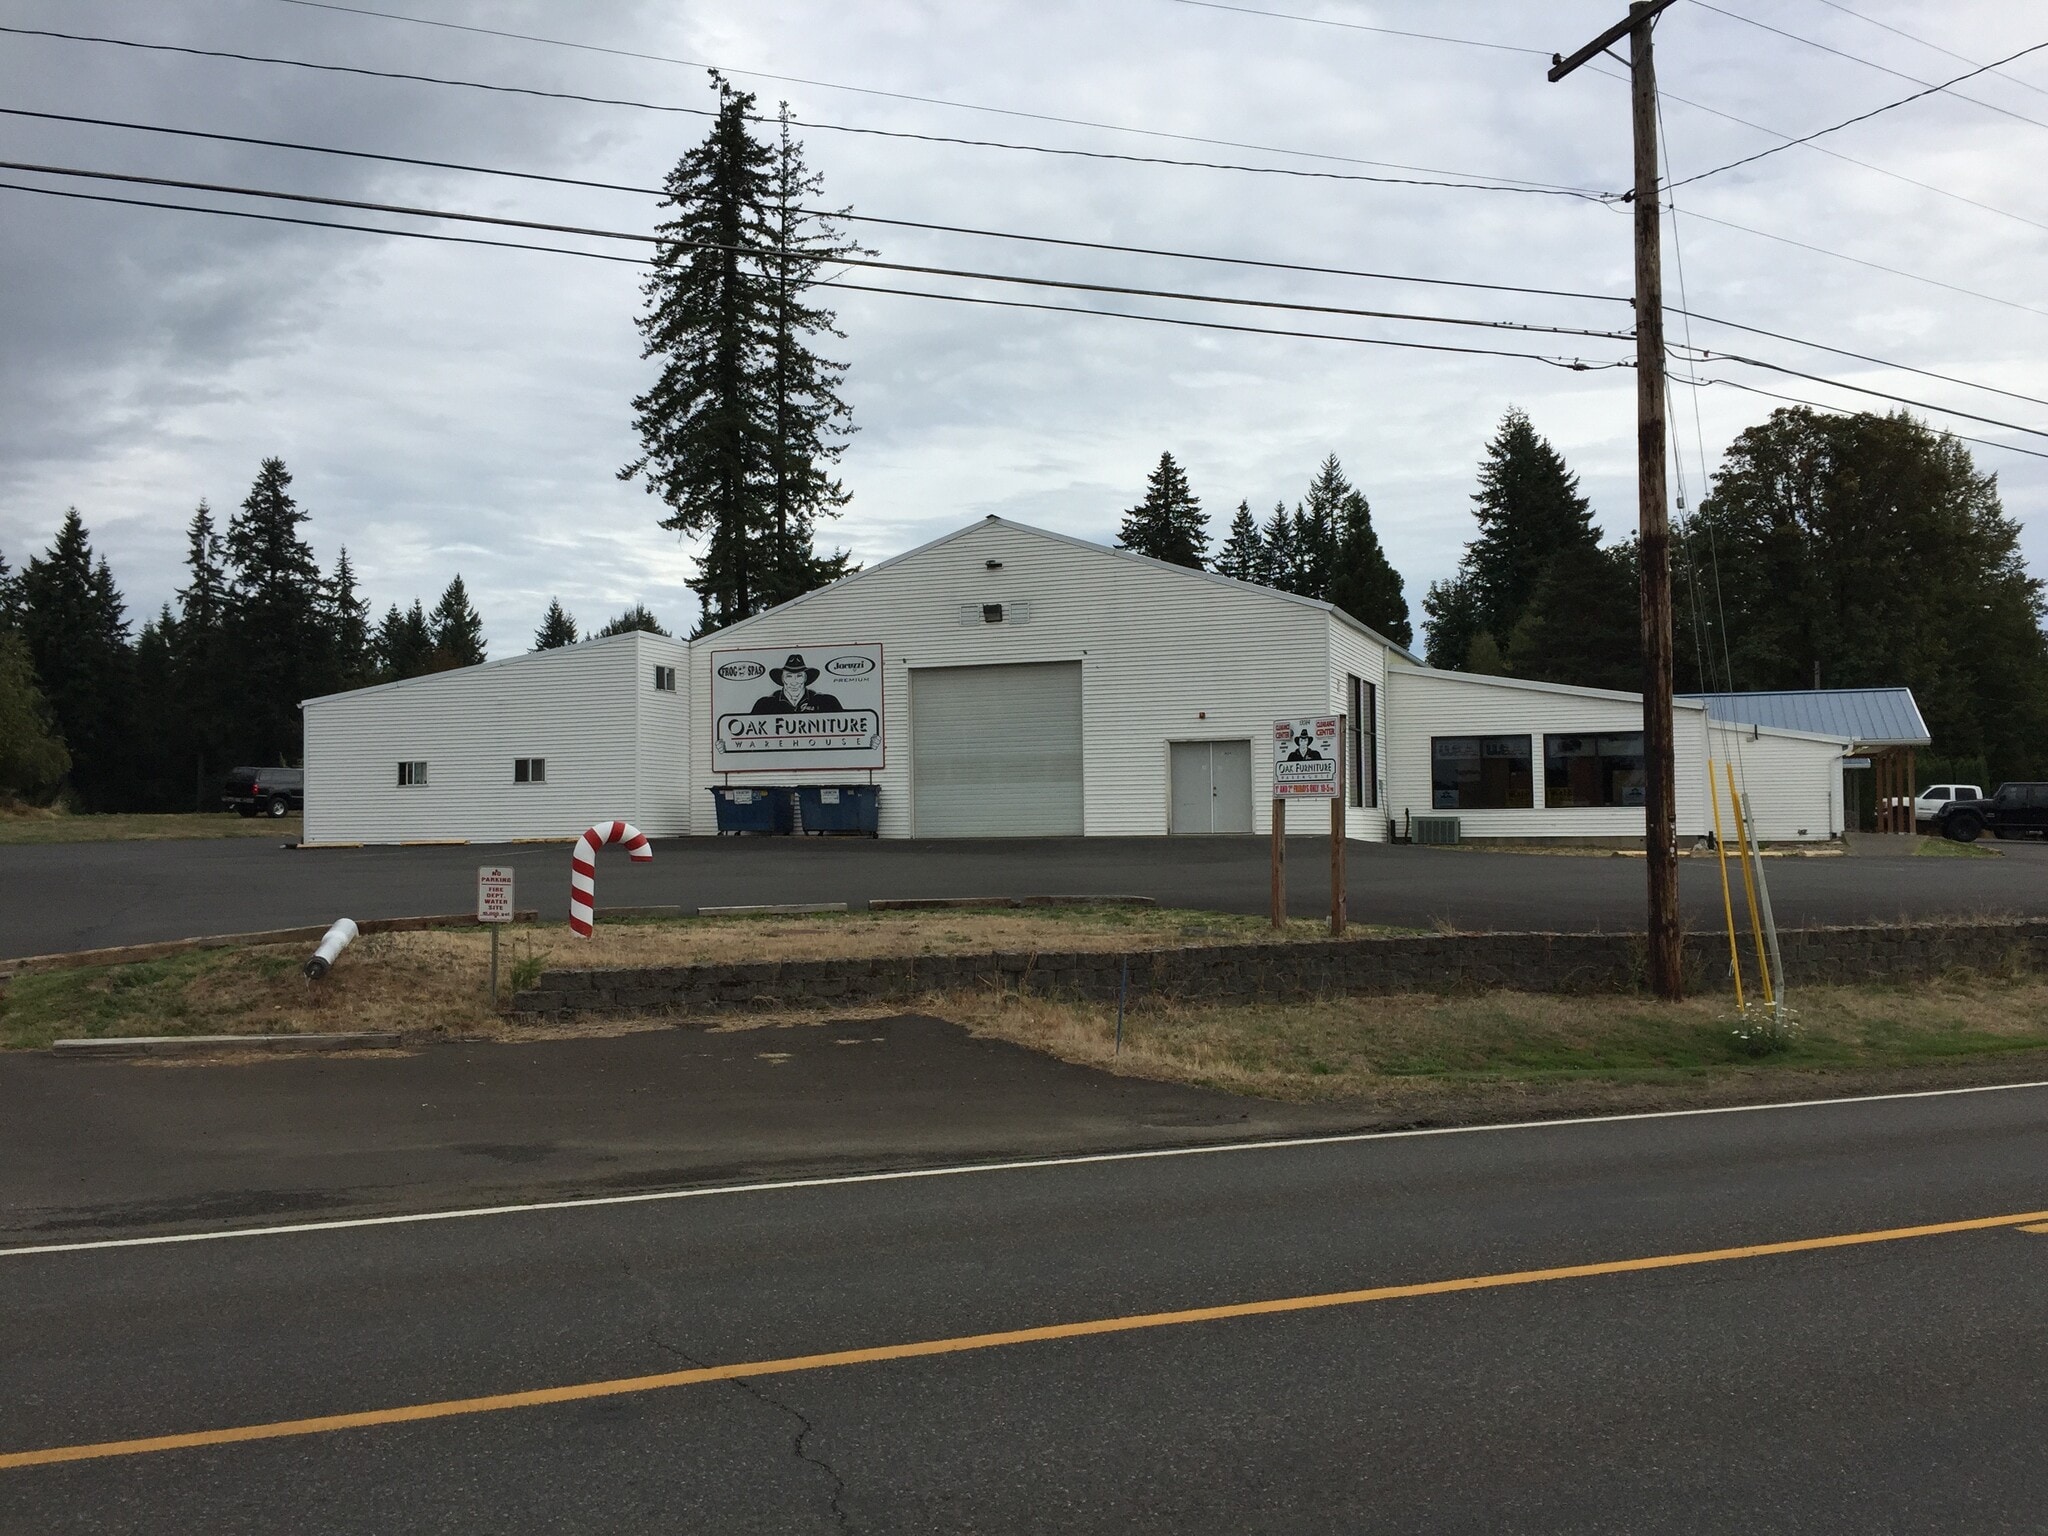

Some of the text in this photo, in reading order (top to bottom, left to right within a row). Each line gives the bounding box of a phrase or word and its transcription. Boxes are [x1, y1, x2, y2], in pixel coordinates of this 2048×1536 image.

[721, 665, 763, 677] FROG SPAS
[833, 660, 865, 671] Jacuzzi
[728, 717, 868, 736] OAK FURNITURE
[1316, 728, 1335, 736] CENTER
[735, 738, 861, 748] WAREHOUSE
[1295, 762, 1332, 773] FURNITURE
